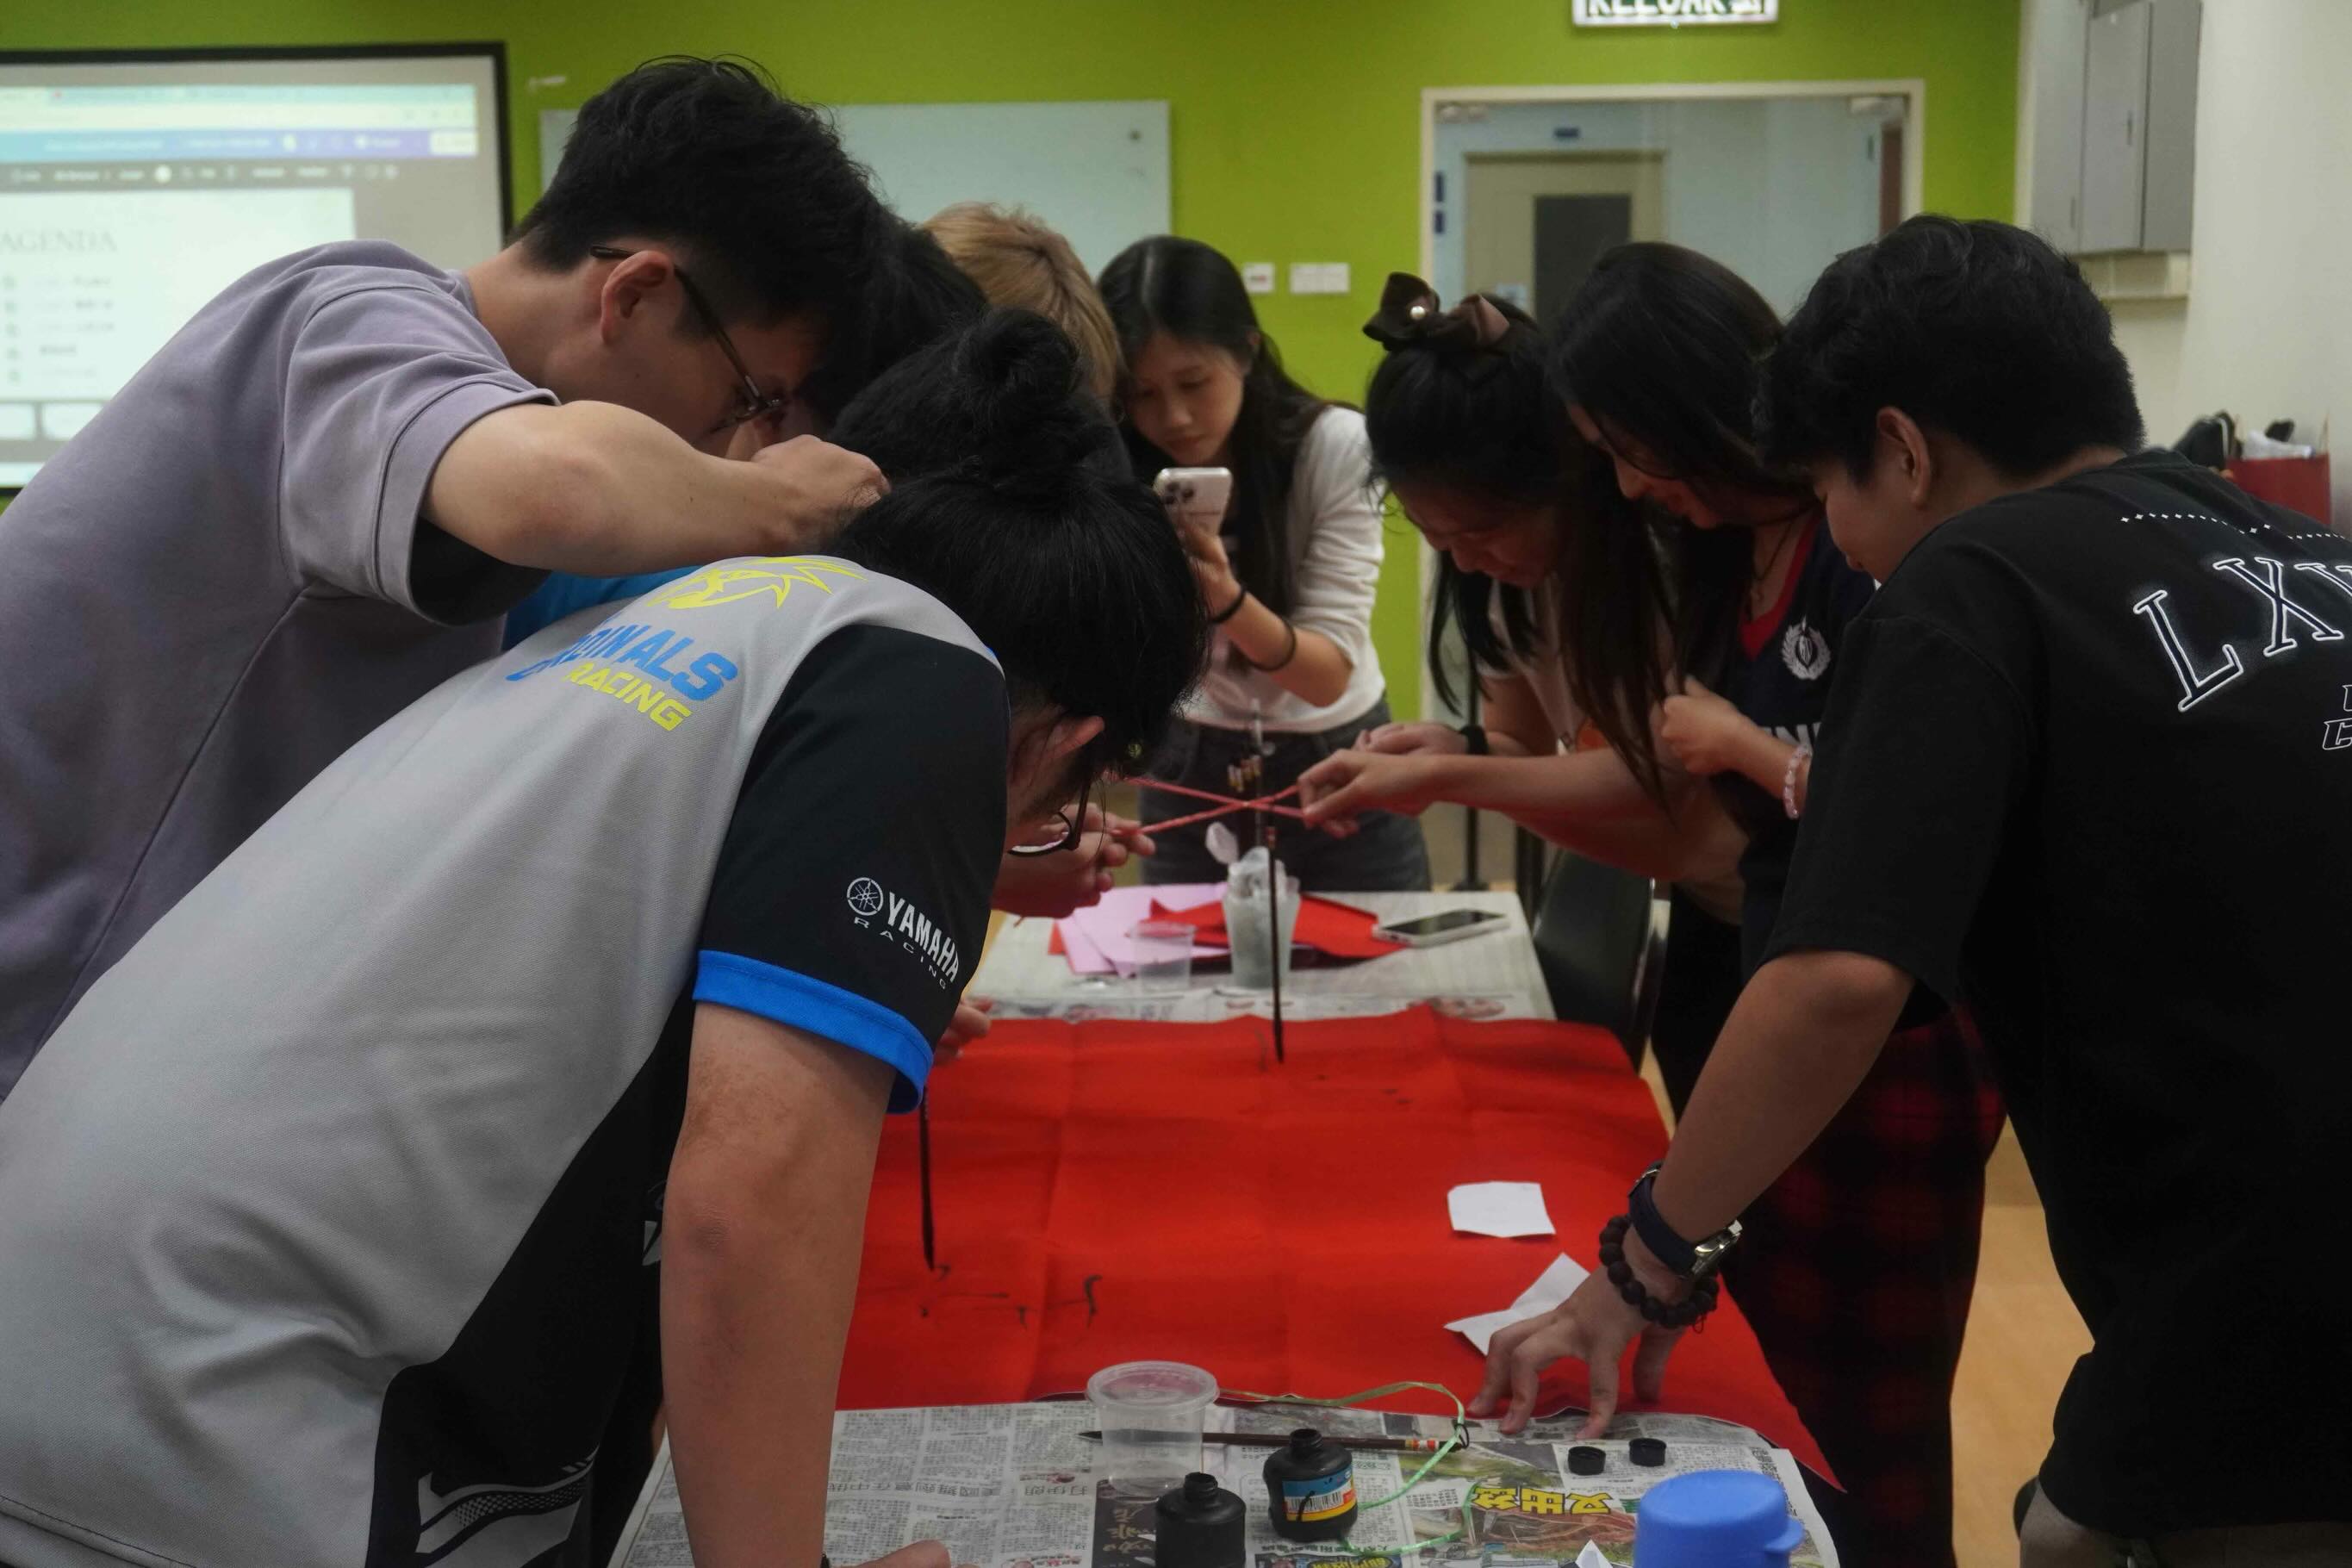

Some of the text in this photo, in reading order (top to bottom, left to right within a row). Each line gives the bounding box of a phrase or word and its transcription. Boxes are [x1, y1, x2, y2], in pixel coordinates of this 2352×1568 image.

[563, 662, 693, 731] RACING
[853, 916, 947, 990] RACING
[887, 891, 959, 984] YAMAHA
